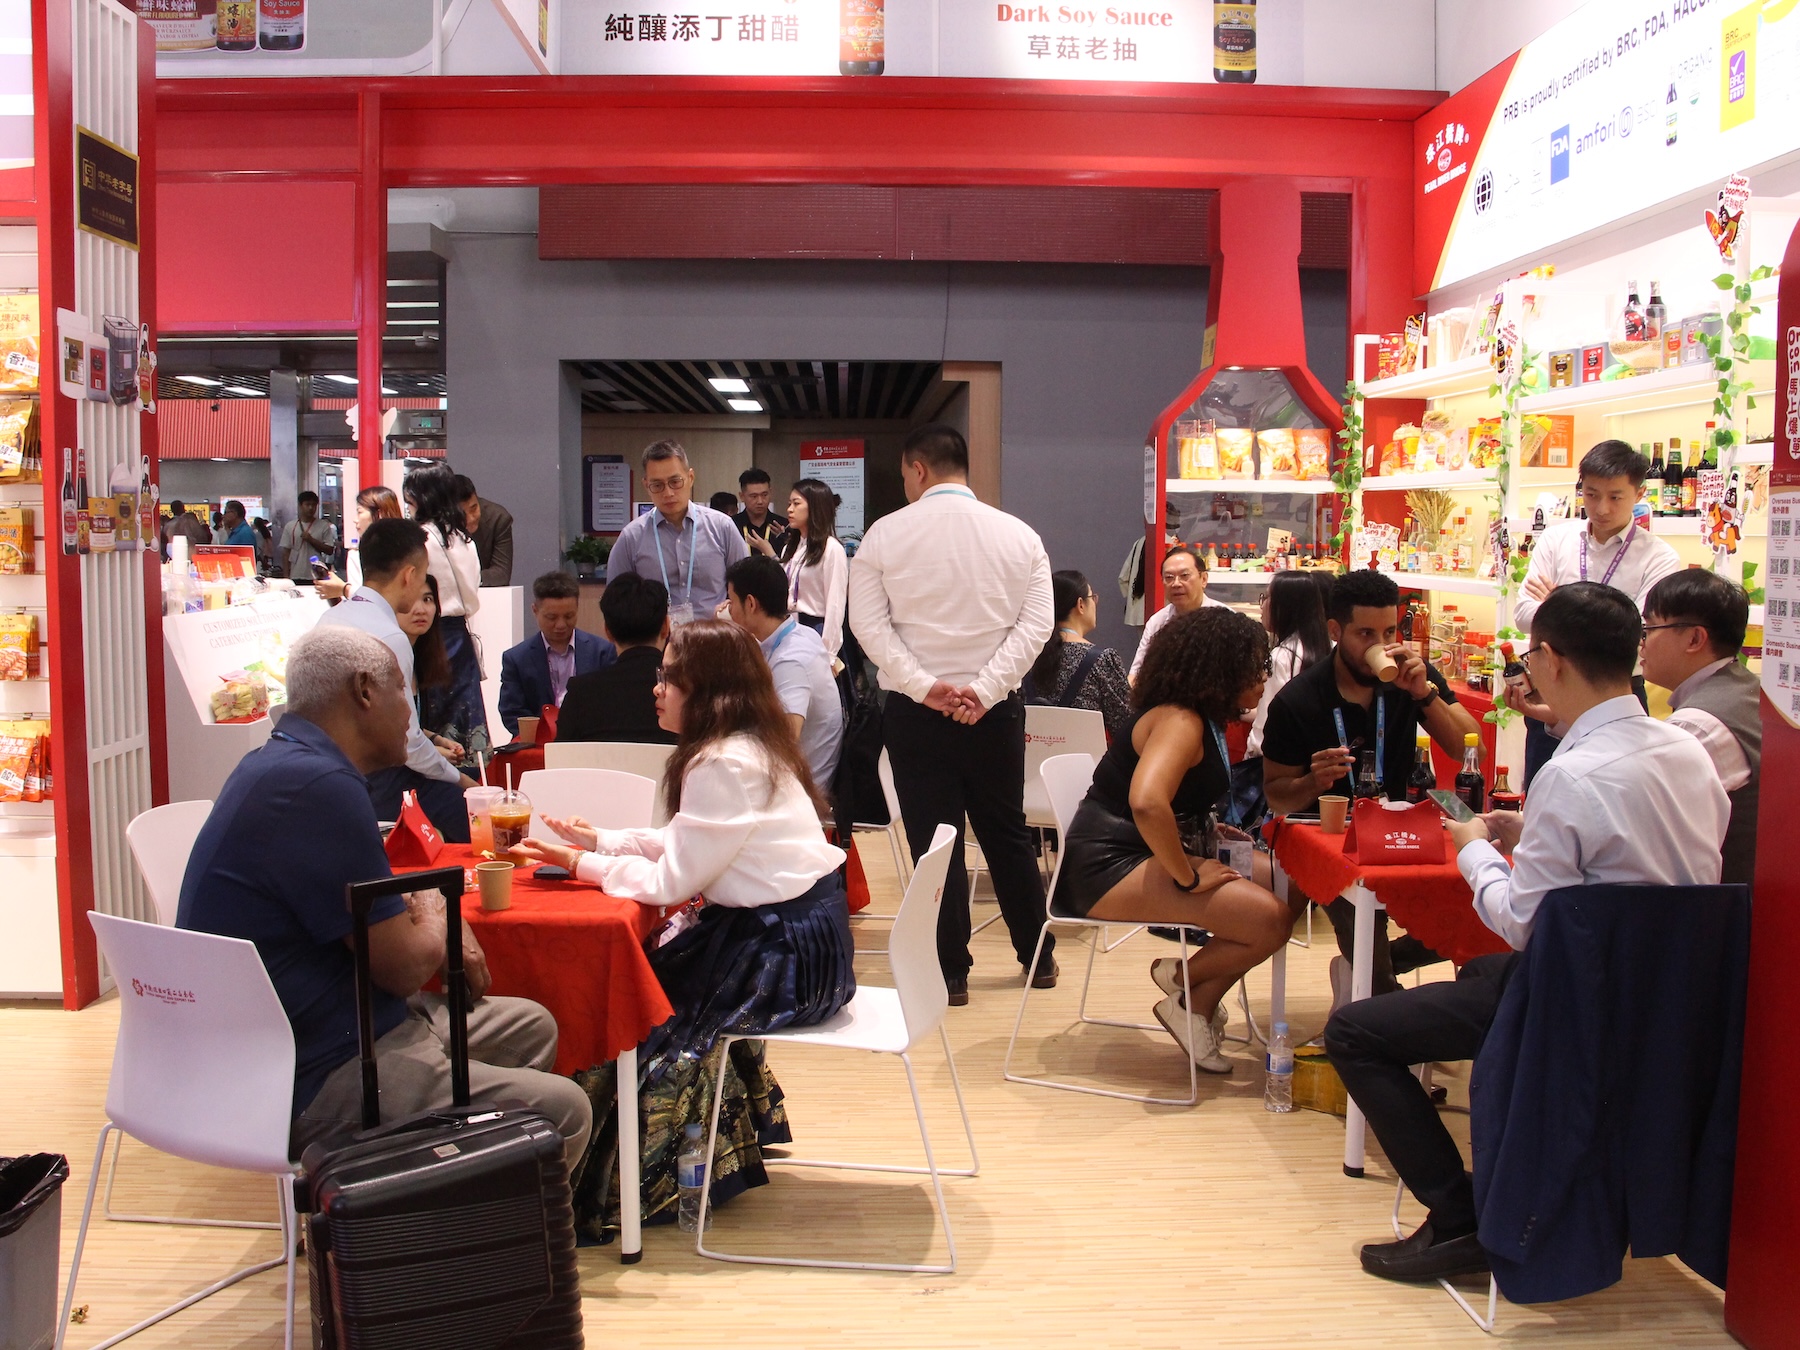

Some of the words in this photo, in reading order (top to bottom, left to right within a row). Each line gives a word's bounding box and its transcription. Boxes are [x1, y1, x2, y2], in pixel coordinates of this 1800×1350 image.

[997, 4, 1050, 22] Dark
[1058, 5, 1098, 28] Soy
[1105, 7, 1173, 27] Sauce
[604, 13, 800, 42] 純釀添丁甜醋
[1725, 28, 1739, 43] BRC
[1027, 34, 1137, 61] 草菇老抽
[1503, 101, 1519, 125] PRB
[1521, 98, 1527, 114] is
[1530, 78, 1559, 114] proudly
[1562, 50, 1600, 89] certified
[1603, 46, 1613, 68] by
[1617, 28, 1641, 57] BRC,
[1645, 11, 1669, 41] FDA,
[1678, 47, 1713, 79] ORGANIC
[1729, 73, 1745, 88] BRC
[1576, 114, 1616, 154] amfori
[1551, 134, 1569, 158] FDA
[1730, 173, 1747, 187] Super
[1725, 186, 1749, 201] booming
[1702, 473, 1724, 483] Orders
[1702, 482, 1725, 492] coming
[1702, 491, 1709, 499] in
[1710, 489, 1724, 498] fast
[1365, 529, 1379, 537] Sing
[1368, 522, 1383, 530] Yam
[203, 617, 247, 634] CUSTOMIZED
[209, 632, 245, 649] CATERING
